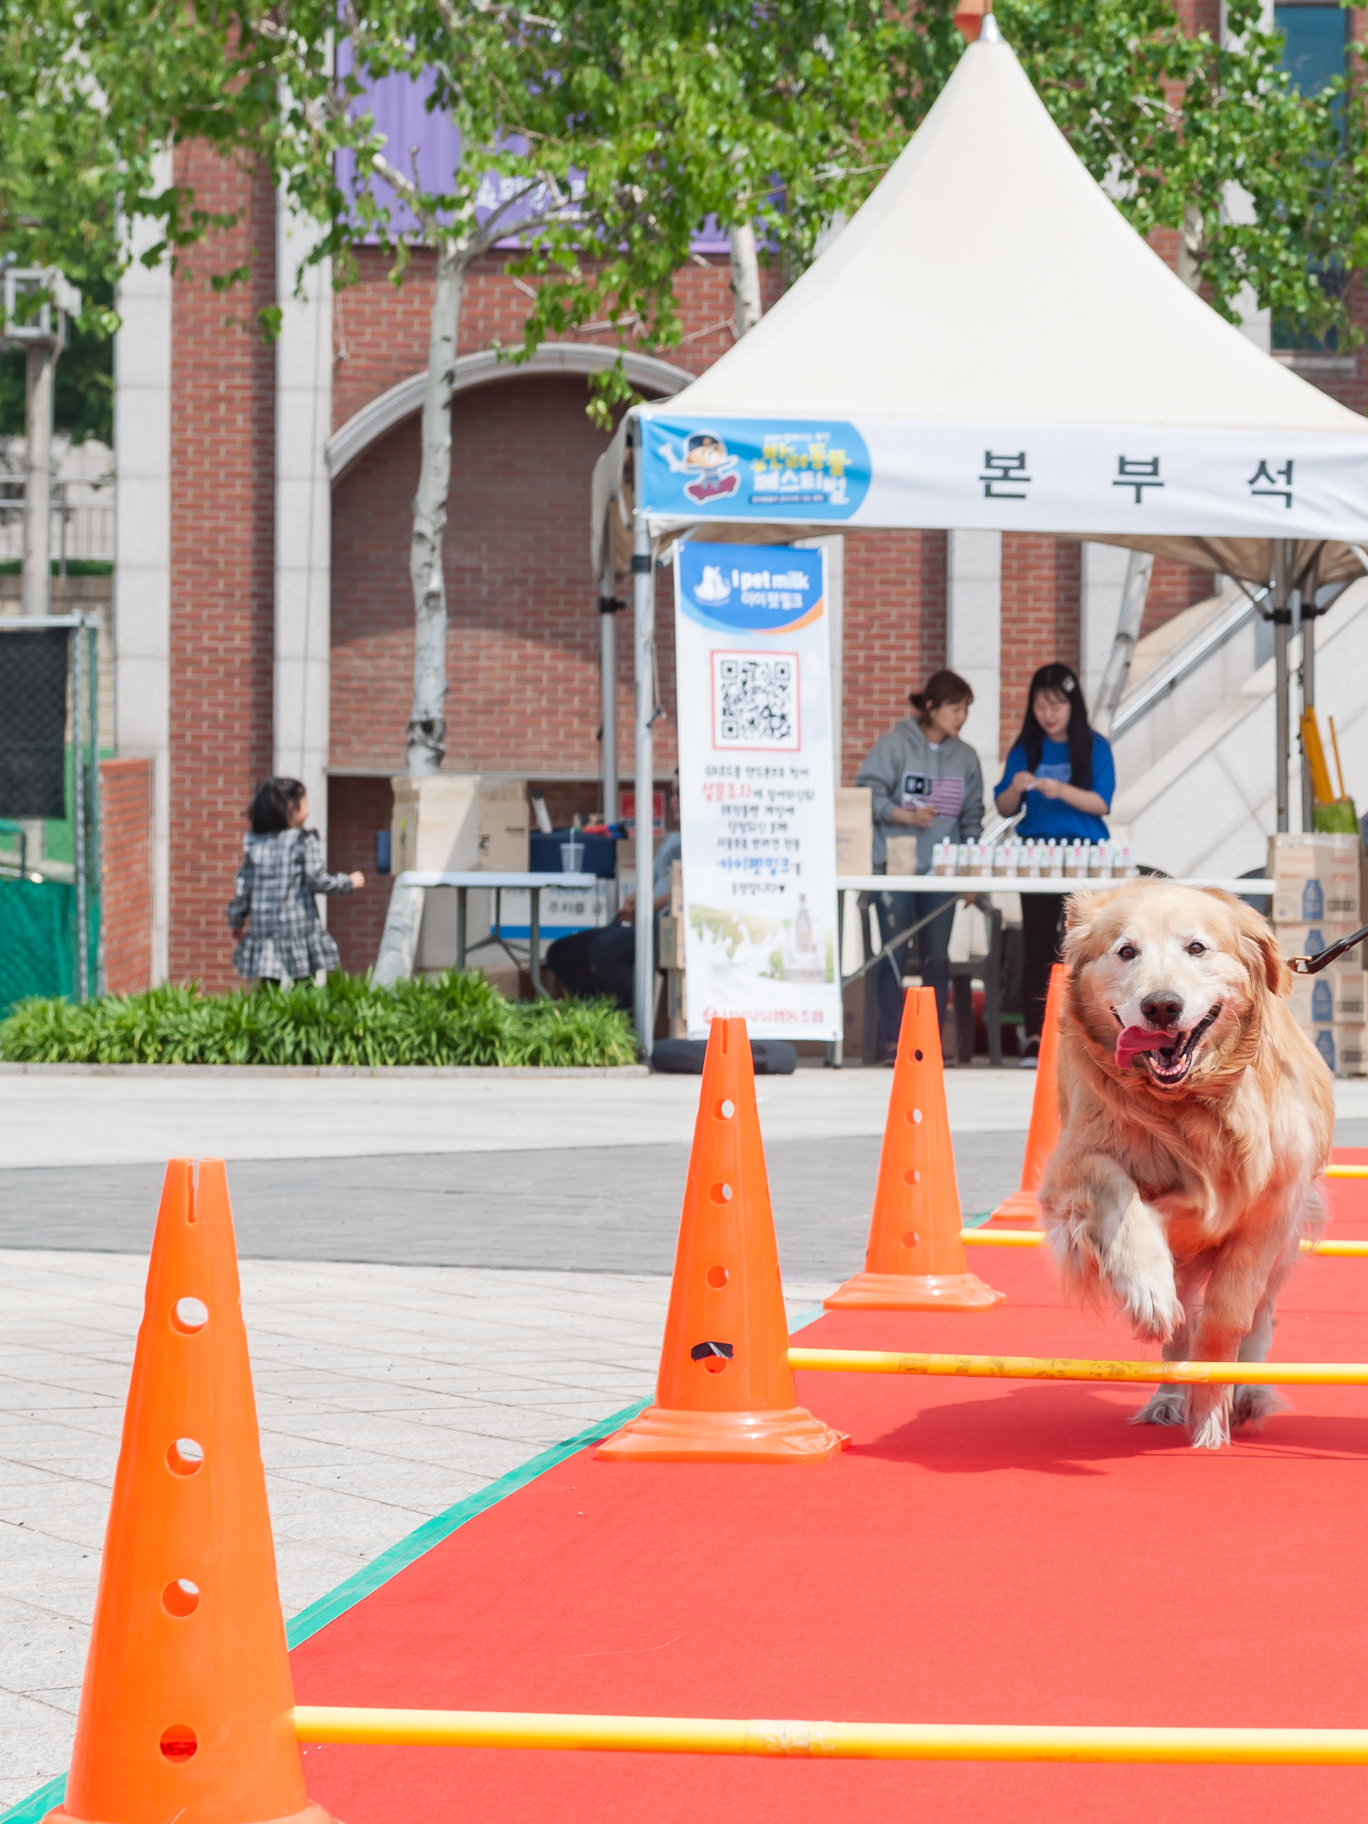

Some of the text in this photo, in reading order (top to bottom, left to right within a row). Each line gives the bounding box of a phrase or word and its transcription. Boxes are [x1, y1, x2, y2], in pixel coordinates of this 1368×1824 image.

[753, 470, 850, 505] 페스티벌
[978, 450, 1294, 509] 본 부 석
[740, 570, 771, 592] pet
[771, 570, 810, 591] milk
